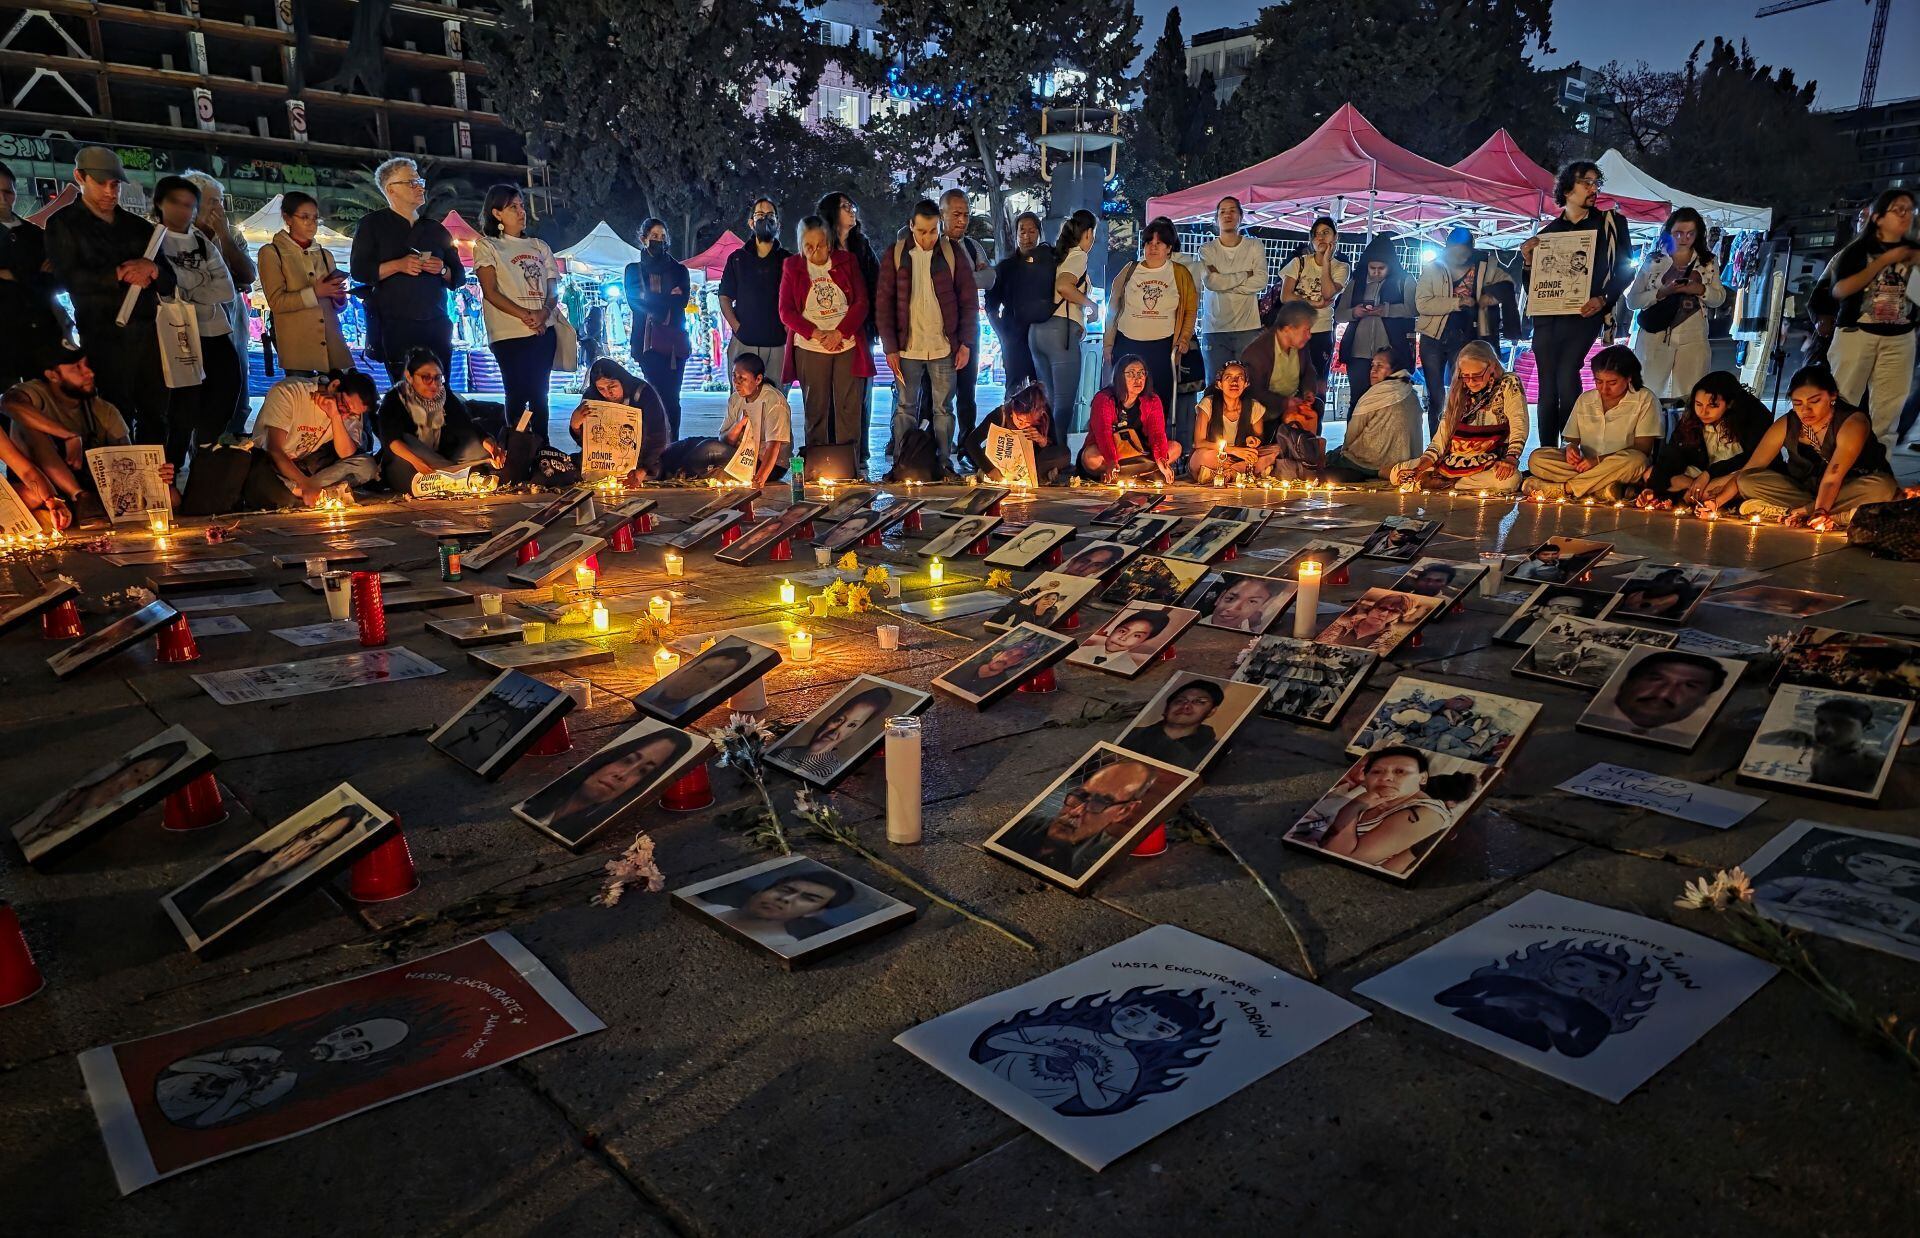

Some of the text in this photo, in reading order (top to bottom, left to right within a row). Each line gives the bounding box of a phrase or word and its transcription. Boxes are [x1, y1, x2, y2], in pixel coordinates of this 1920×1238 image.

[1533, 280, 1562, 292] ¿DÓNDE
[587, 450, 613, 461] ¿DÓNDE
[1507, 923, 1556, 931] HASTA
[1111, 961, 1265, 997] HASTA ENCONTRARTE
[1652, 954, 1702, 991] JUAN
[405, 971, 524, 1015] HASTA ENCONTRARTE
[481, 1013, 500, 1036] JUAN
[1234, 999, 1273, 1039] ADRIÁN
